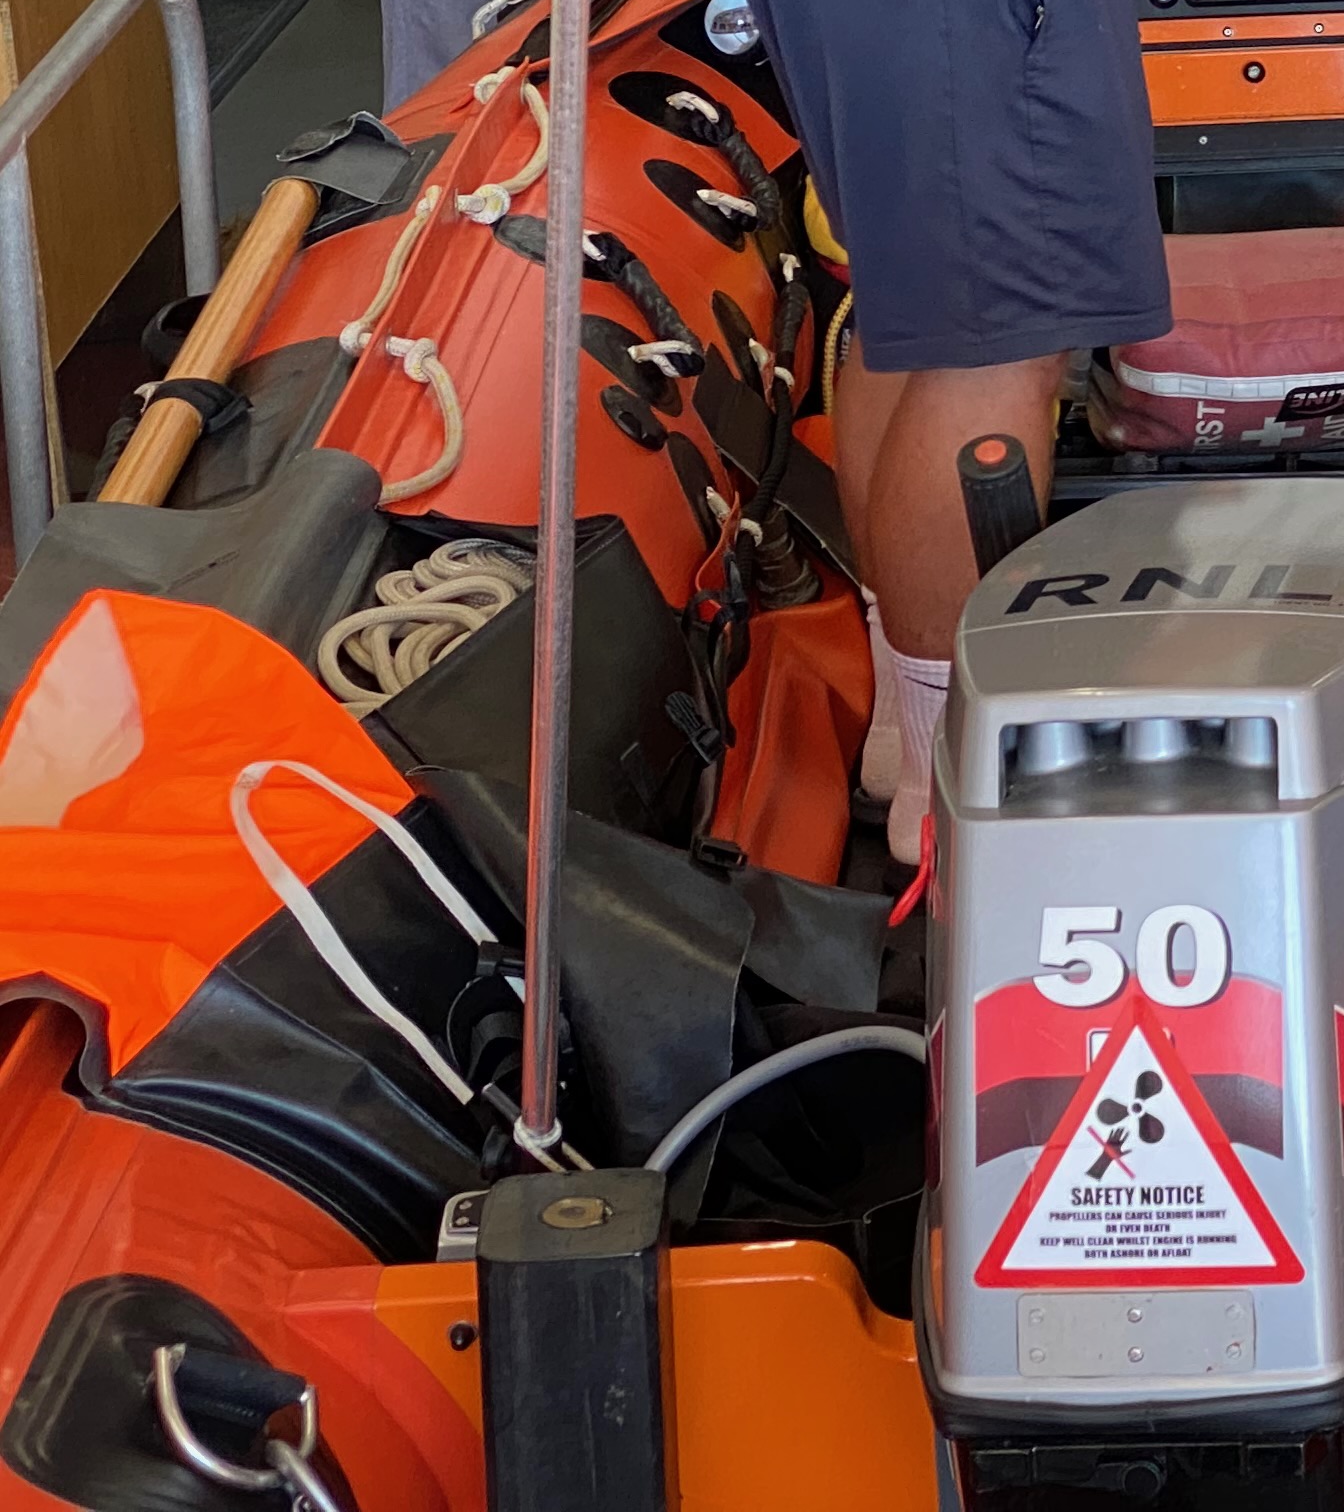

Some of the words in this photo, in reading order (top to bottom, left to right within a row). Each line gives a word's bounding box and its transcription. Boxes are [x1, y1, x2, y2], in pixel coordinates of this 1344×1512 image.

[1032, 904, 1233, 1008] 50
[1071, 1186, 1136, 1206] SAFETY
[1139, 1184, 1206, 1206] NOTICE
[1049, 1211, 1102, 1222] PROPELLERS
[1104, 1211, 1123, 1221] CAN
[1125, 1211, 1153, 1220] CAUSE
[1156, 1210, 1193, 1220] SERIOUS
[1195, 1209, 1227, 1219] INJURY
[1105, 1224, 1118, 1233] OR
[1120, 1223, 1141, 1233] EVEN
[1143, 1223, 1171, 1232] DEATH
[1039, 1237, 1061, 1246] KEEP
[1063, 1237, 1085, 1246] WELL
[1087, 1236, 1114, 1246] CLEAR
[1116, 1236, 1150, 1245] WHILST
[1152, 1235, 1183, 1245] ENGINE
[1185, 1235, 1195, 1245] IS
[1196, 1234, 1237, 1245] RUNNING
[1084, 1249, 1108, 1259] BOTH
[1110, 1248, 1145, 1258] ASHORE
[1146, 1248, 1159, 1258] OR
[1161, 1247, 1192, 1257] AFLOAT
